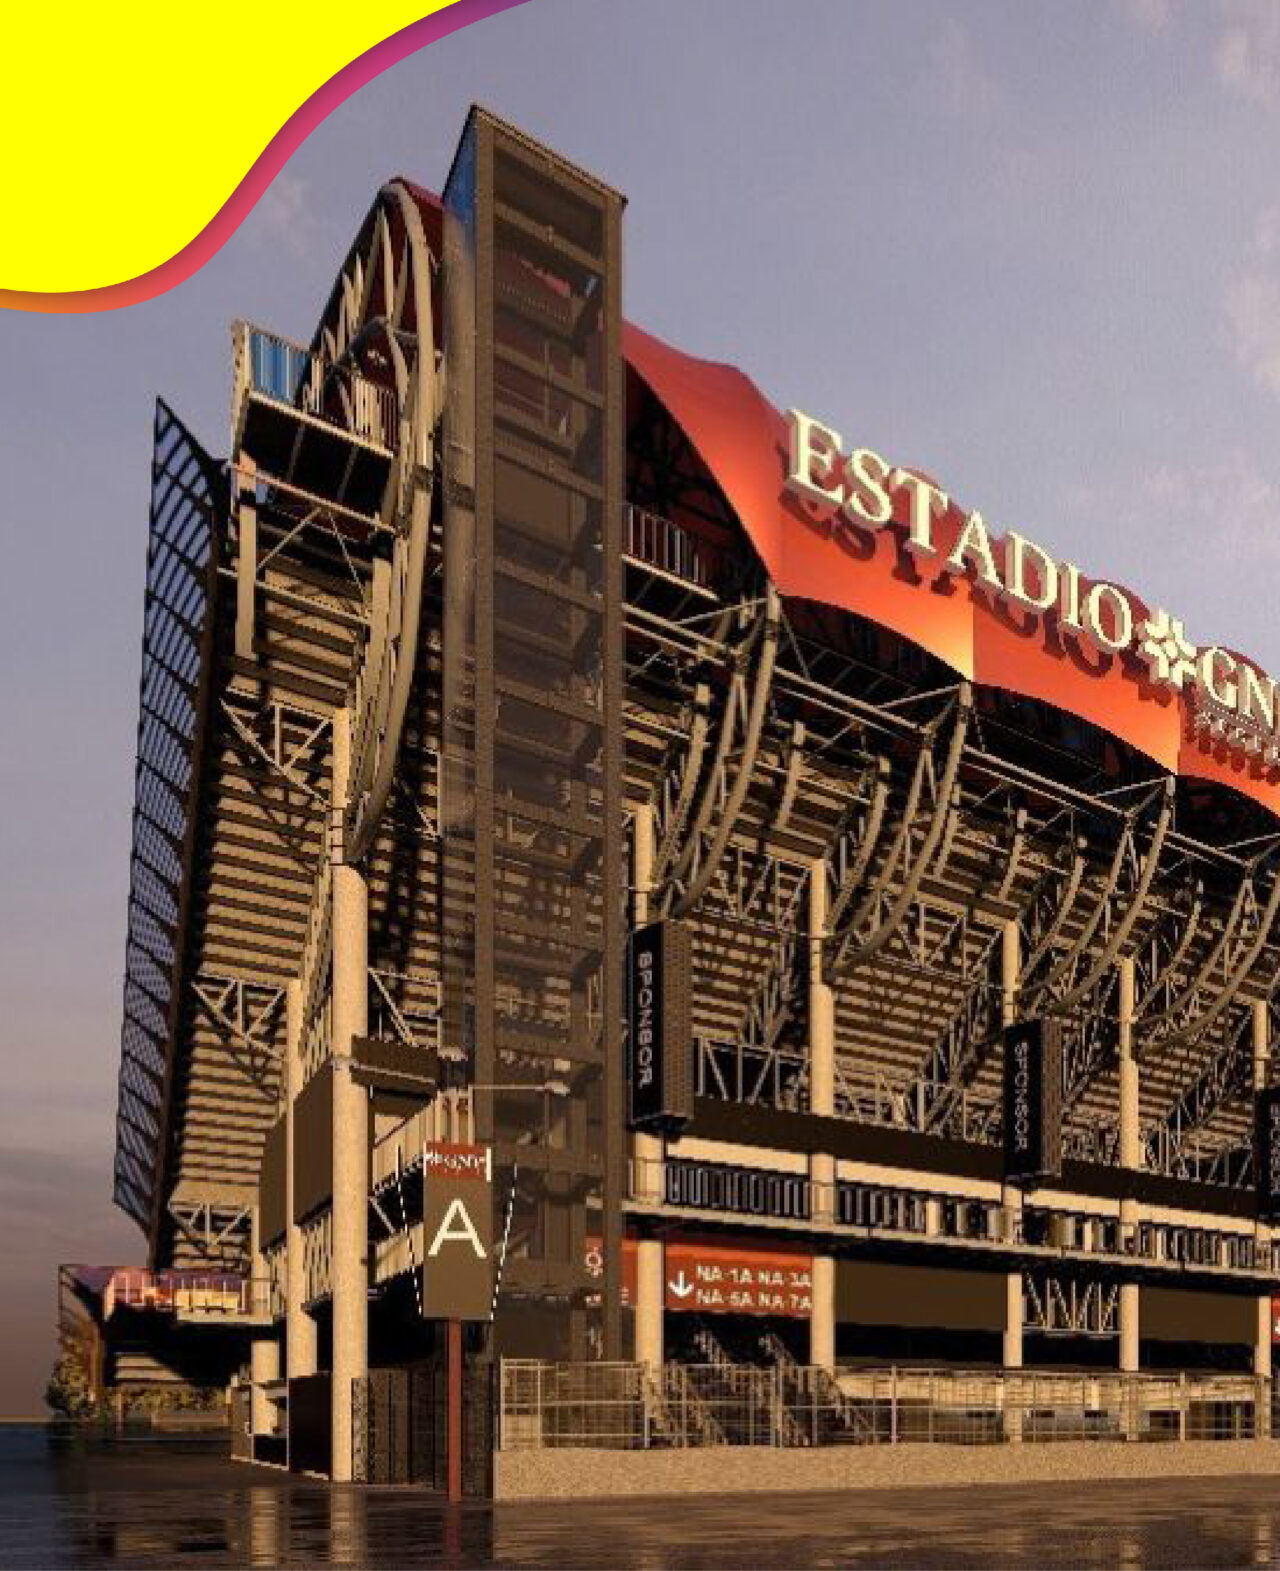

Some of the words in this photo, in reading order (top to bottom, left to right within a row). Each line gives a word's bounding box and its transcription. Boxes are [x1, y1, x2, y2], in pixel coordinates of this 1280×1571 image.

[784, 407, 1134, 655] ESTADIO
[638, 950, 653, 1089] SPONSOR
[1014, 1041, 1029, 1153] SPONSOR
[427, 1198, 488, 1259] A
